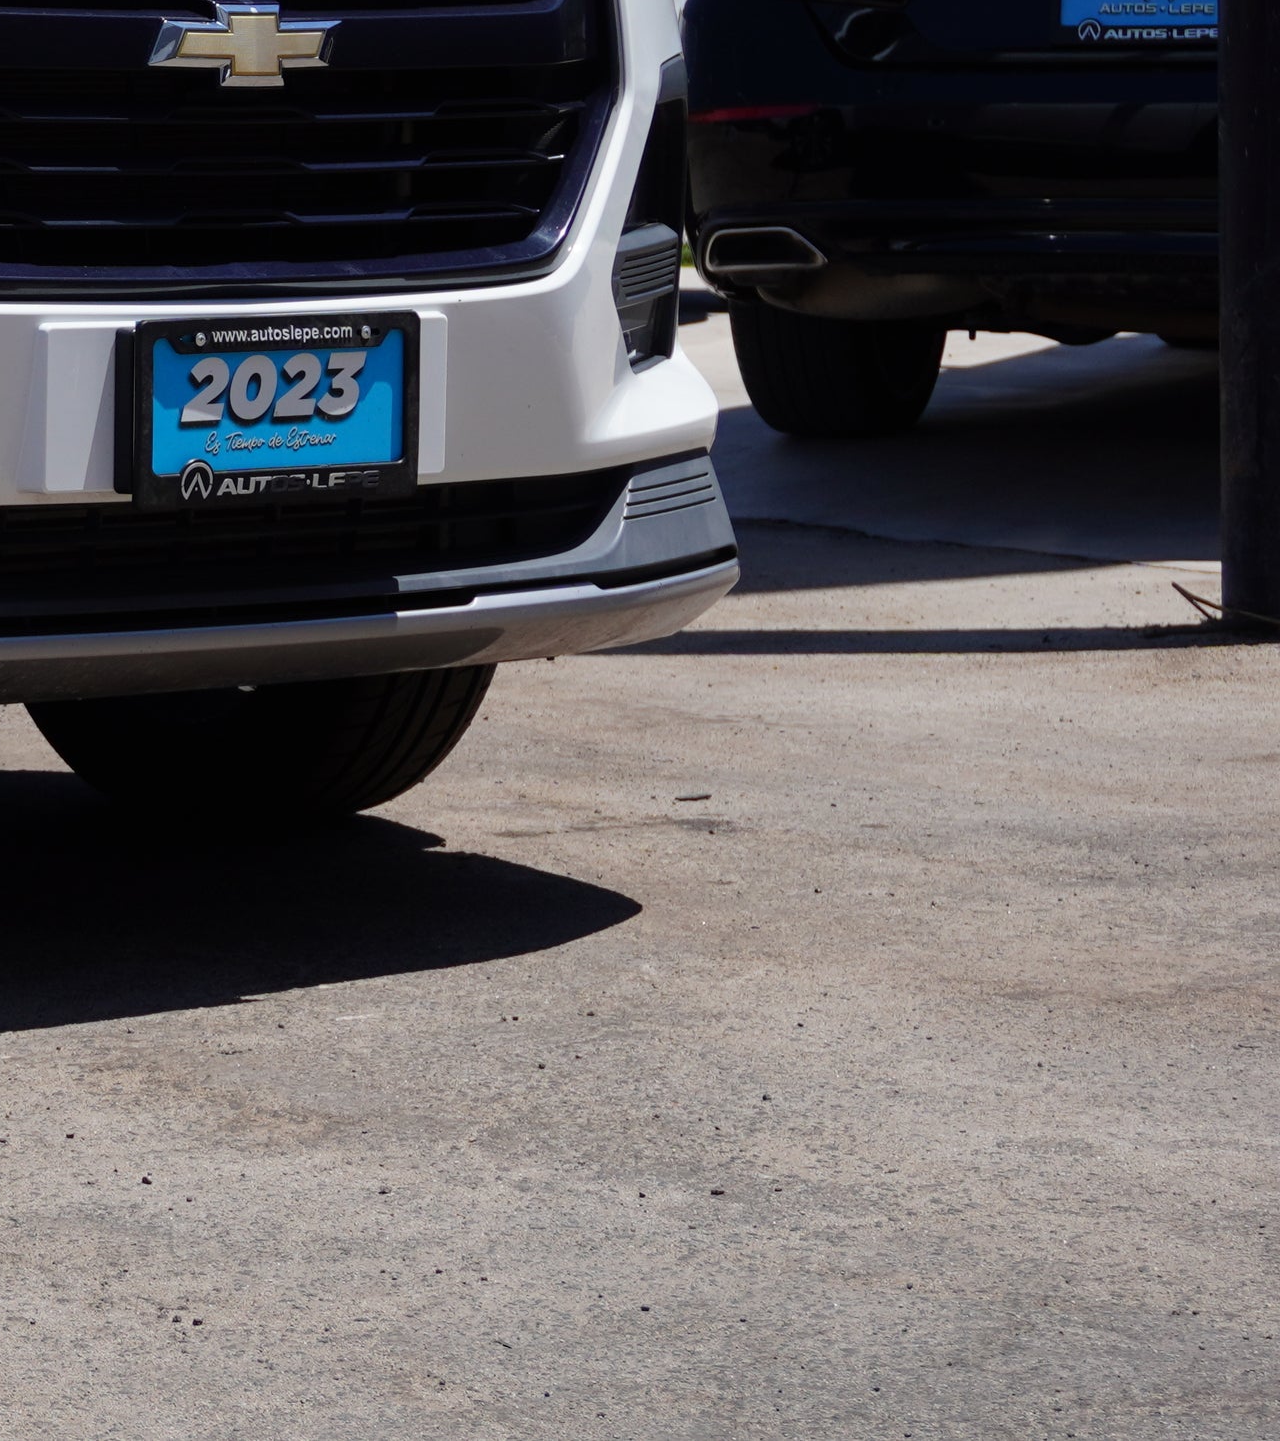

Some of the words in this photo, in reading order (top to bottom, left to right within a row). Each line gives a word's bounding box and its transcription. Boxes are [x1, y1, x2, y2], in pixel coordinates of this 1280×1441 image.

[1099, 3, 1157, 14] AUTOS
[1169, 3, 1215, 14] LEPE
[212, 325, 353, 343] www.autoslepe.com
[179, 350, 368, 424] 2023
[204, 430, 222, 456] Es
[225, 431, 266, 452] Tiempo
[268, 432, 285, 449] de
[285, 425, 338, 451] Estrenar
